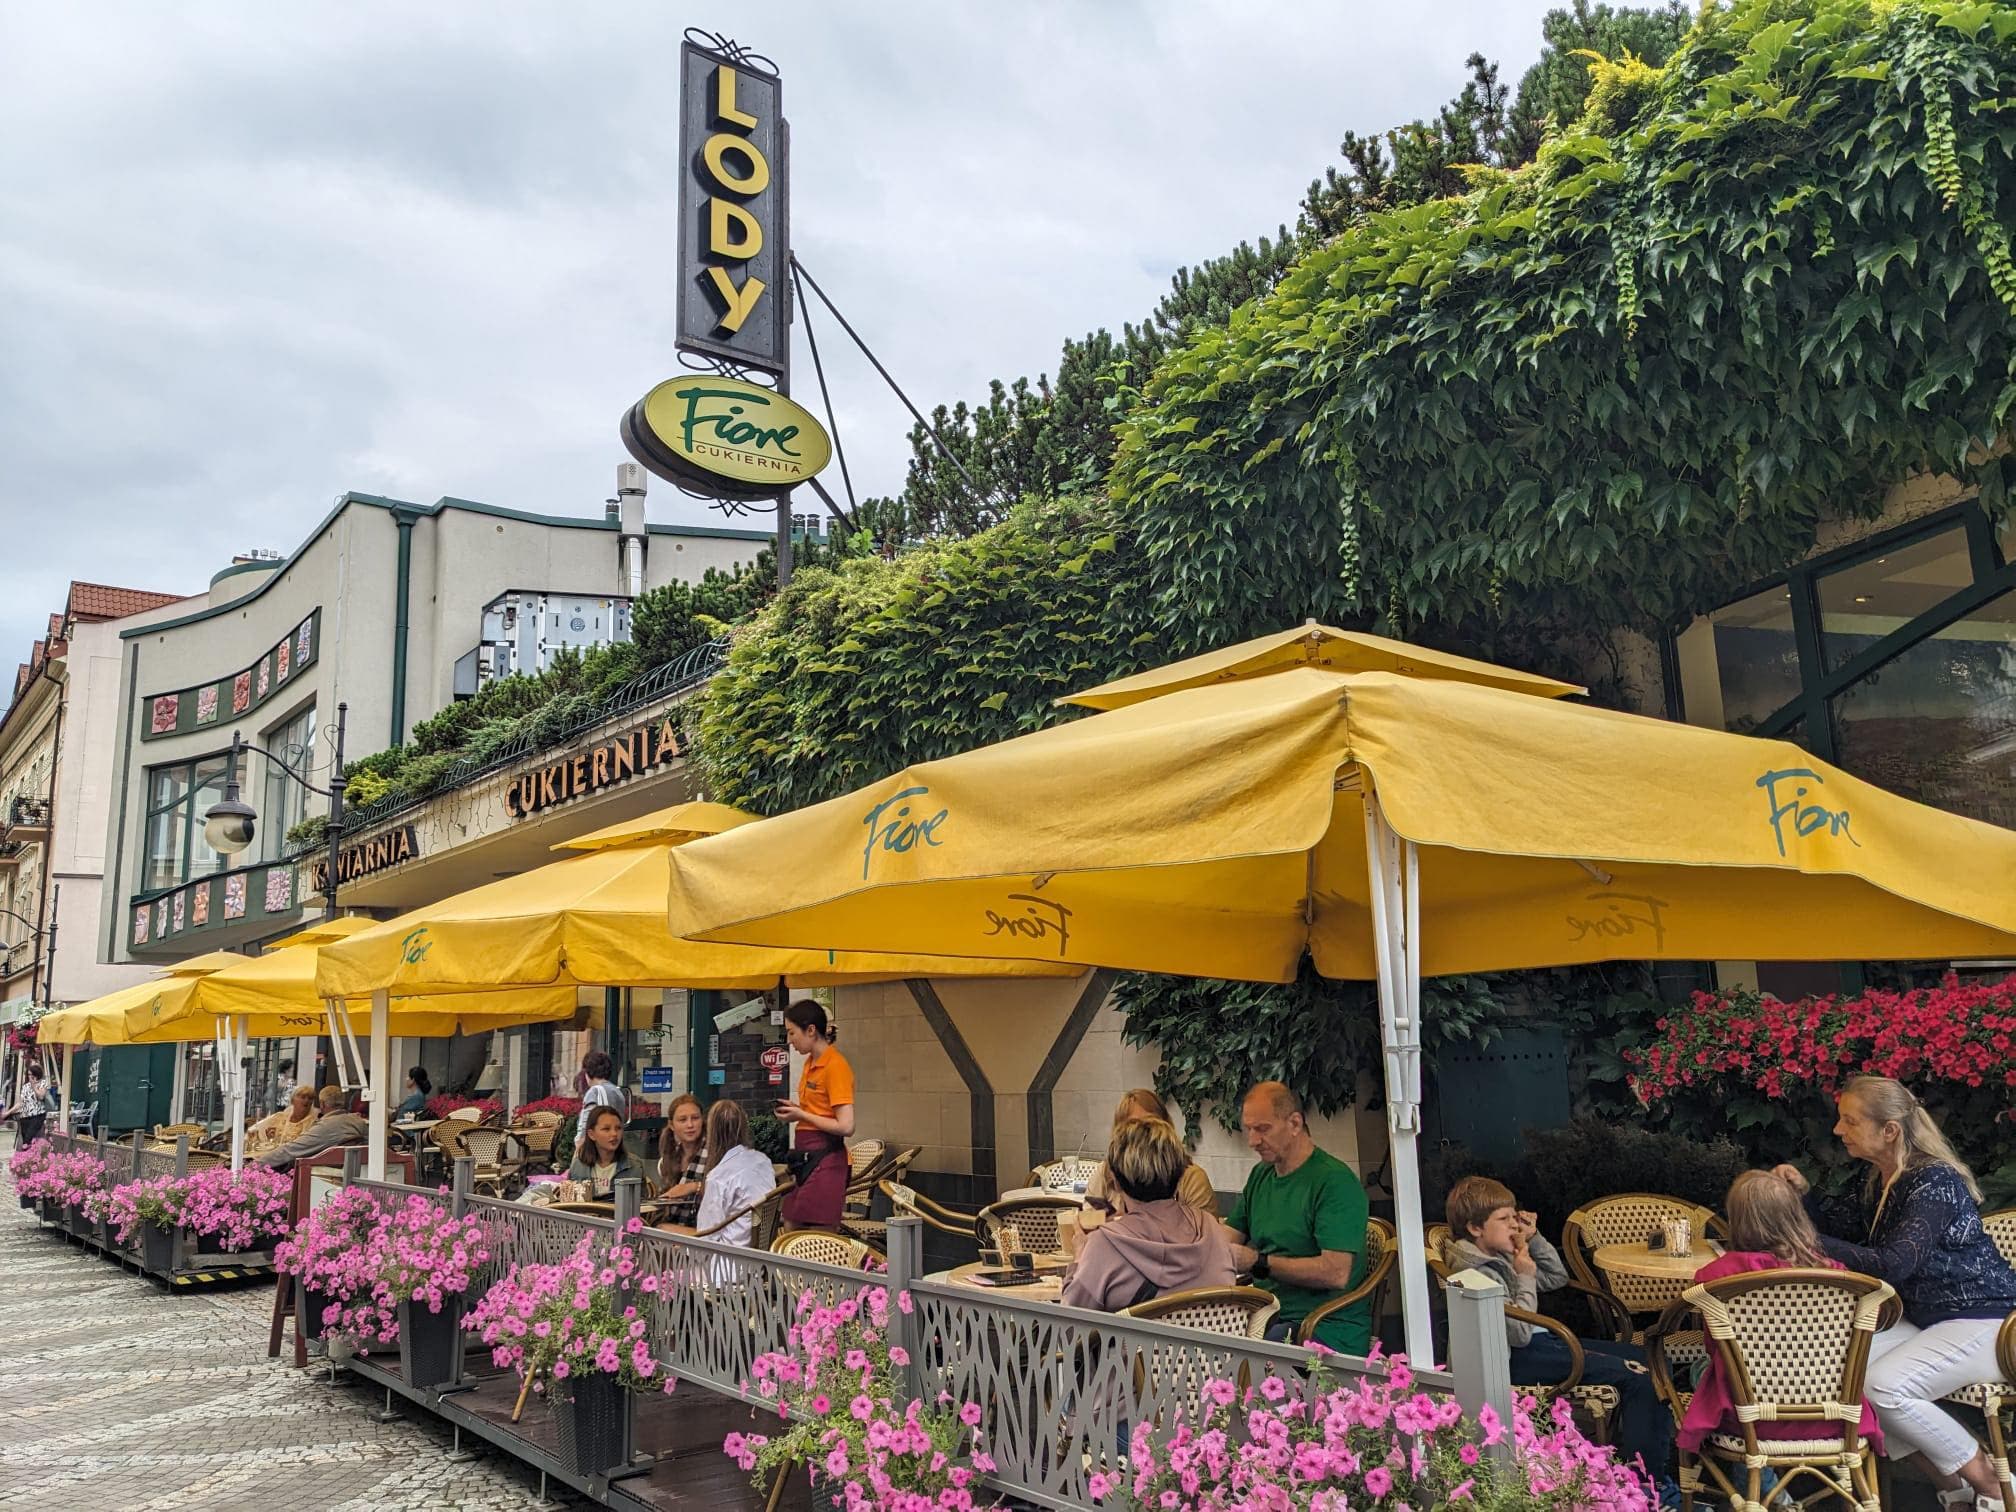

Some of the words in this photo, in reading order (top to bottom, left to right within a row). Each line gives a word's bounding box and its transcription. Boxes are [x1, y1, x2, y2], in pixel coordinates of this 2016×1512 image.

[703, 65, 770, 333] LODY
[676, 388, 801, 457] Fiore
[695, 444, 801, 475] CUKIERNIA
[504, 719, 680, 818] CUKIERNIA
[863, 786, 949, 880] Fiore
